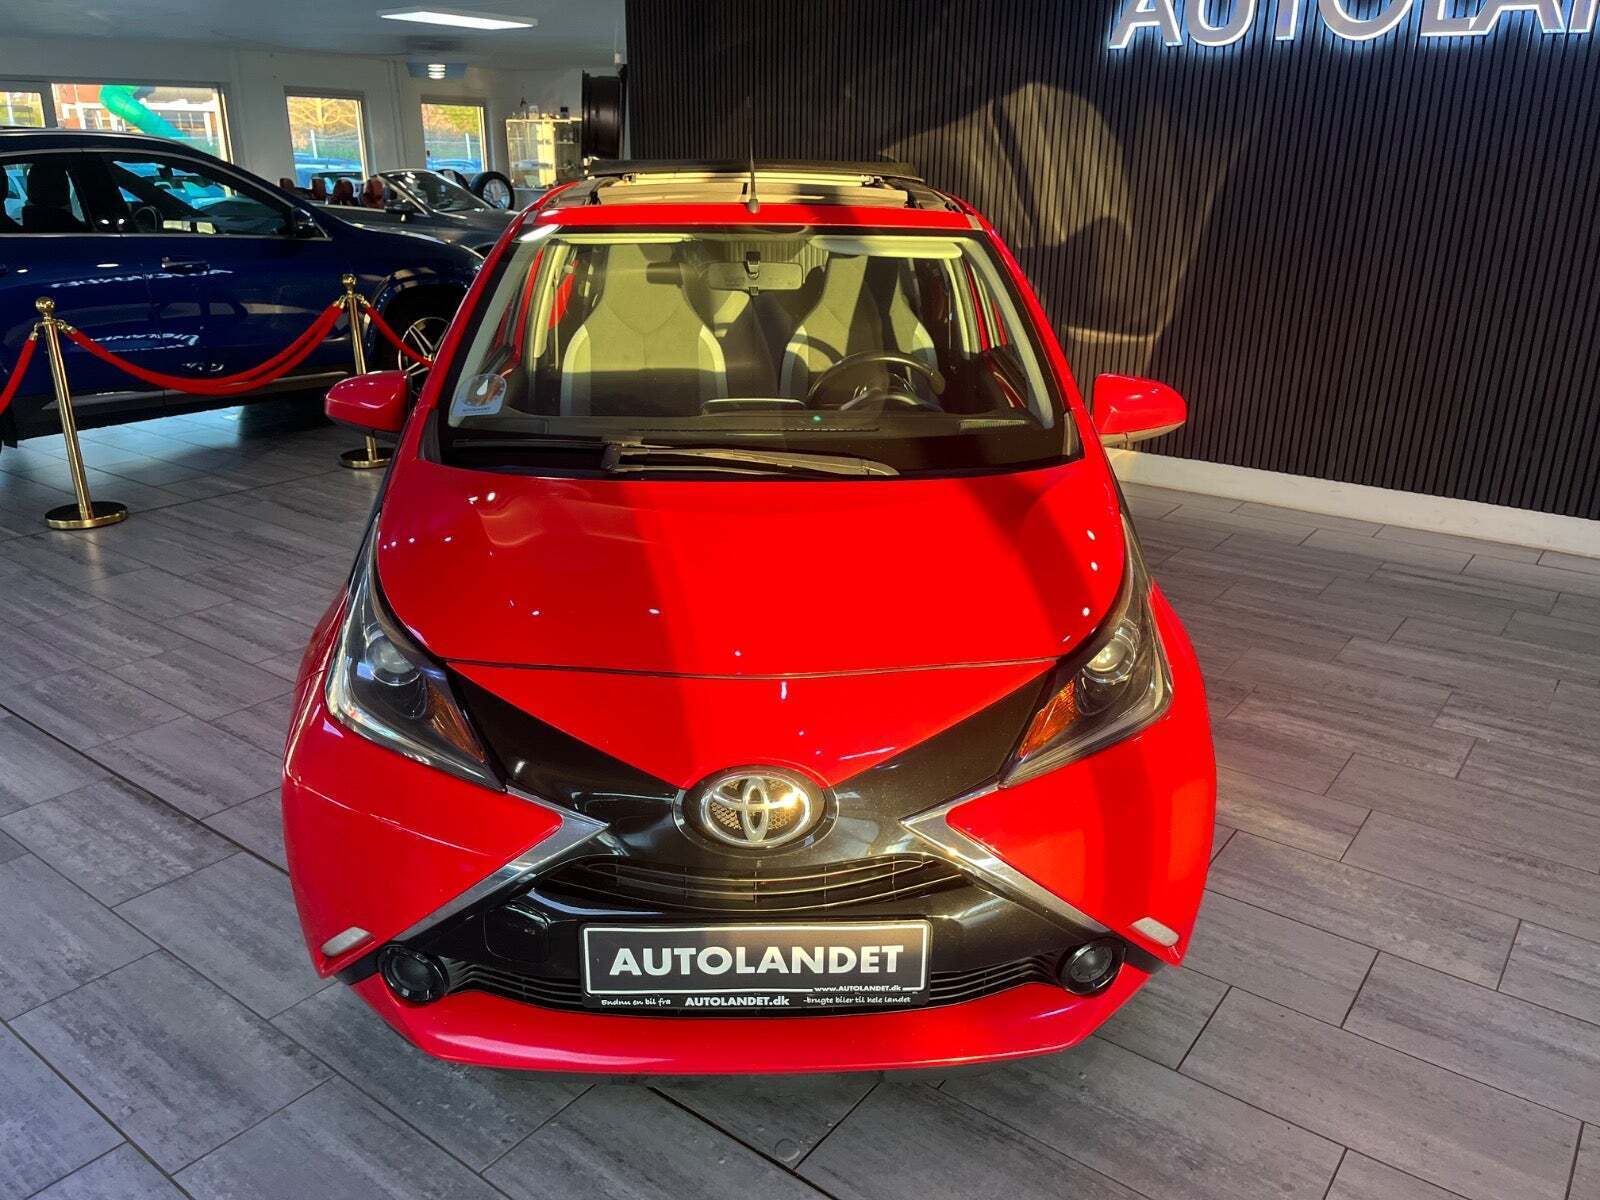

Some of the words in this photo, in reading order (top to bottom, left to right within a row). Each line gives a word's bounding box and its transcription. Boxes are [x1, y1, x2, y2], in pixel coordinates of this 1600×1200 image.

[1108, 0, 1599, 49] AUTOLA
[609, 945, 904, 976] AUTOLANDET
[813, 984, 902, 992] www.AUTOLANDET.dk
[658, 998, 671, 1007] fra
[684, 995, 790, 1007] AUTOLANDET.dk
[835, 996, 854, 1004] biler
[884, 995, 911, 1003] landet
